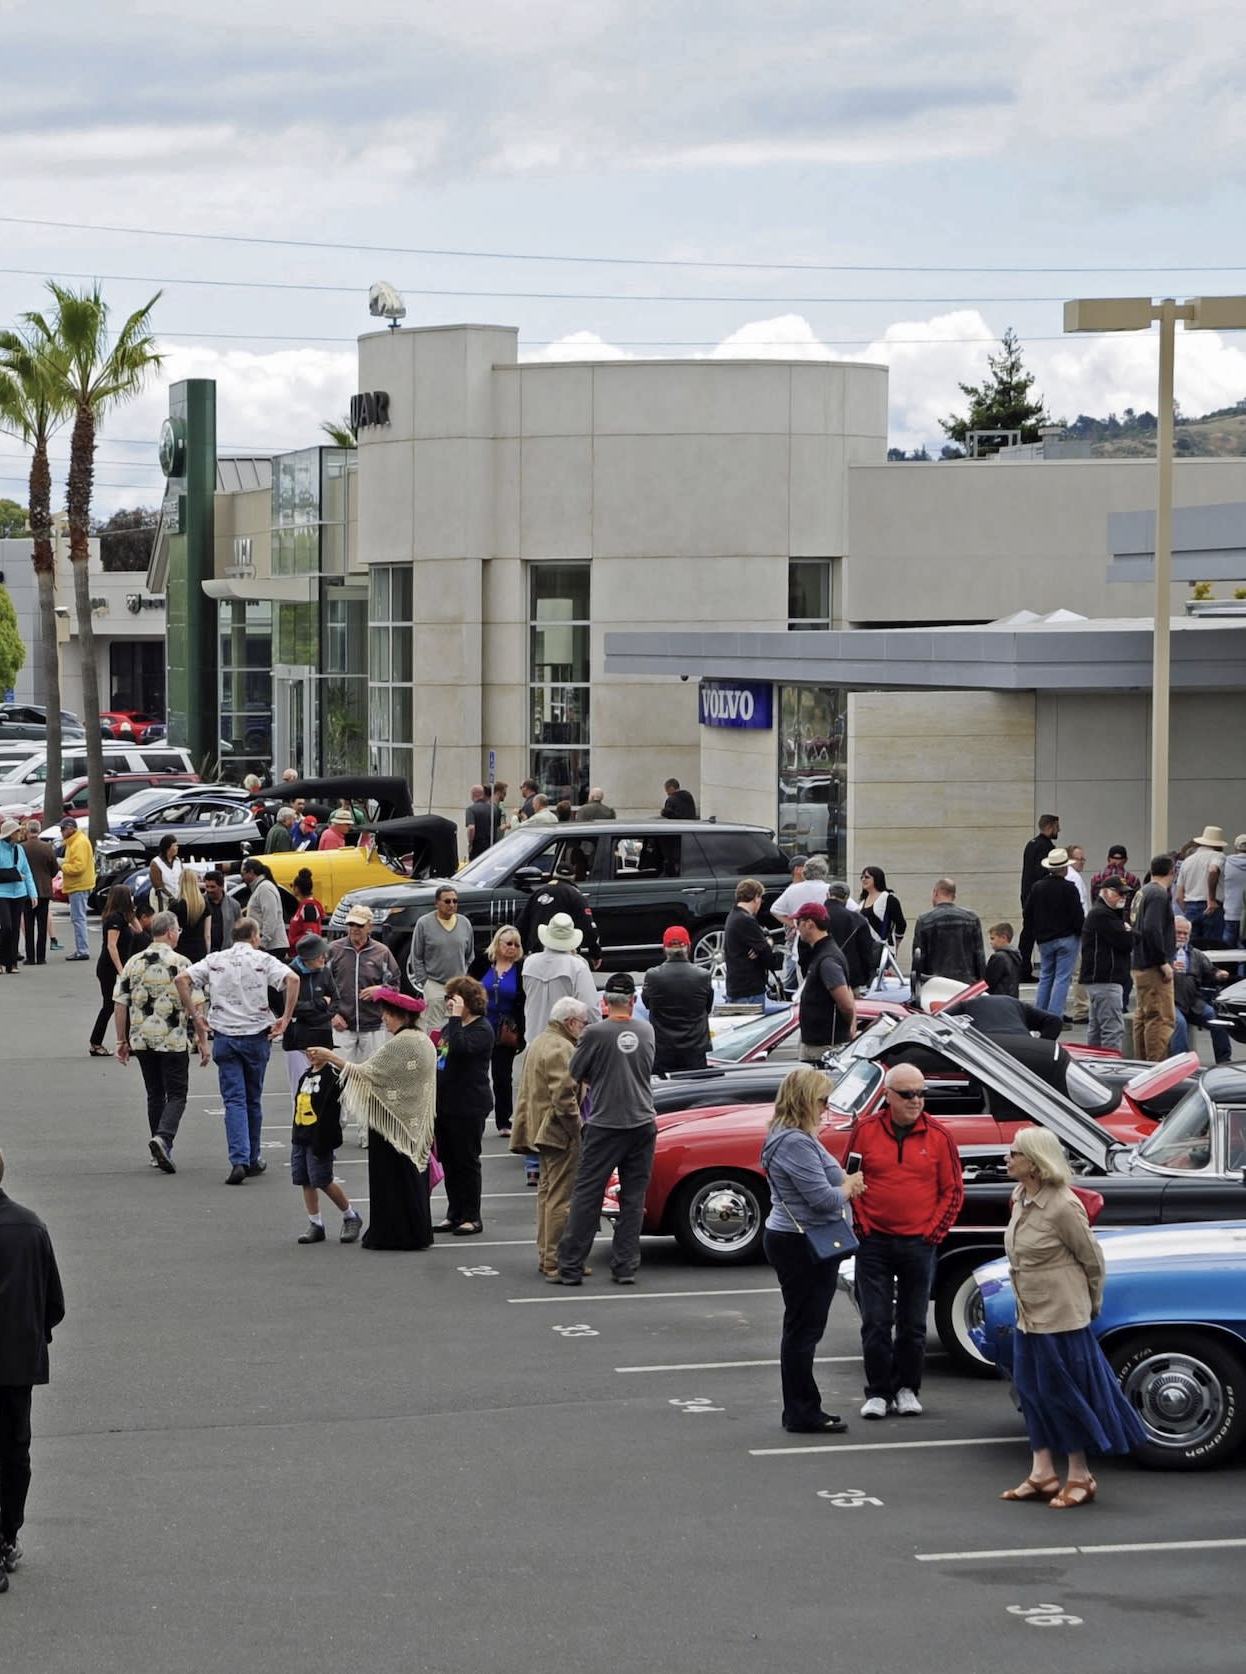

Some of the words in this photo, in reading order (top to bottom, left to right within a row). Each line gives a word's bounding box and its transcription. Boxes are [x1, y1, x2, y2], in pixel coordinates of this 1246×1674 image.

[702, 689, 754, 720] VOLVO
[457, 1265, 500, 1277] 32
[552, 1324, 600, 1337] 33
[668, 1397, 725, 1413] 34
[816, 1489, 884, 1507] 35
[1006, 1603, 1083, 1626] 36
